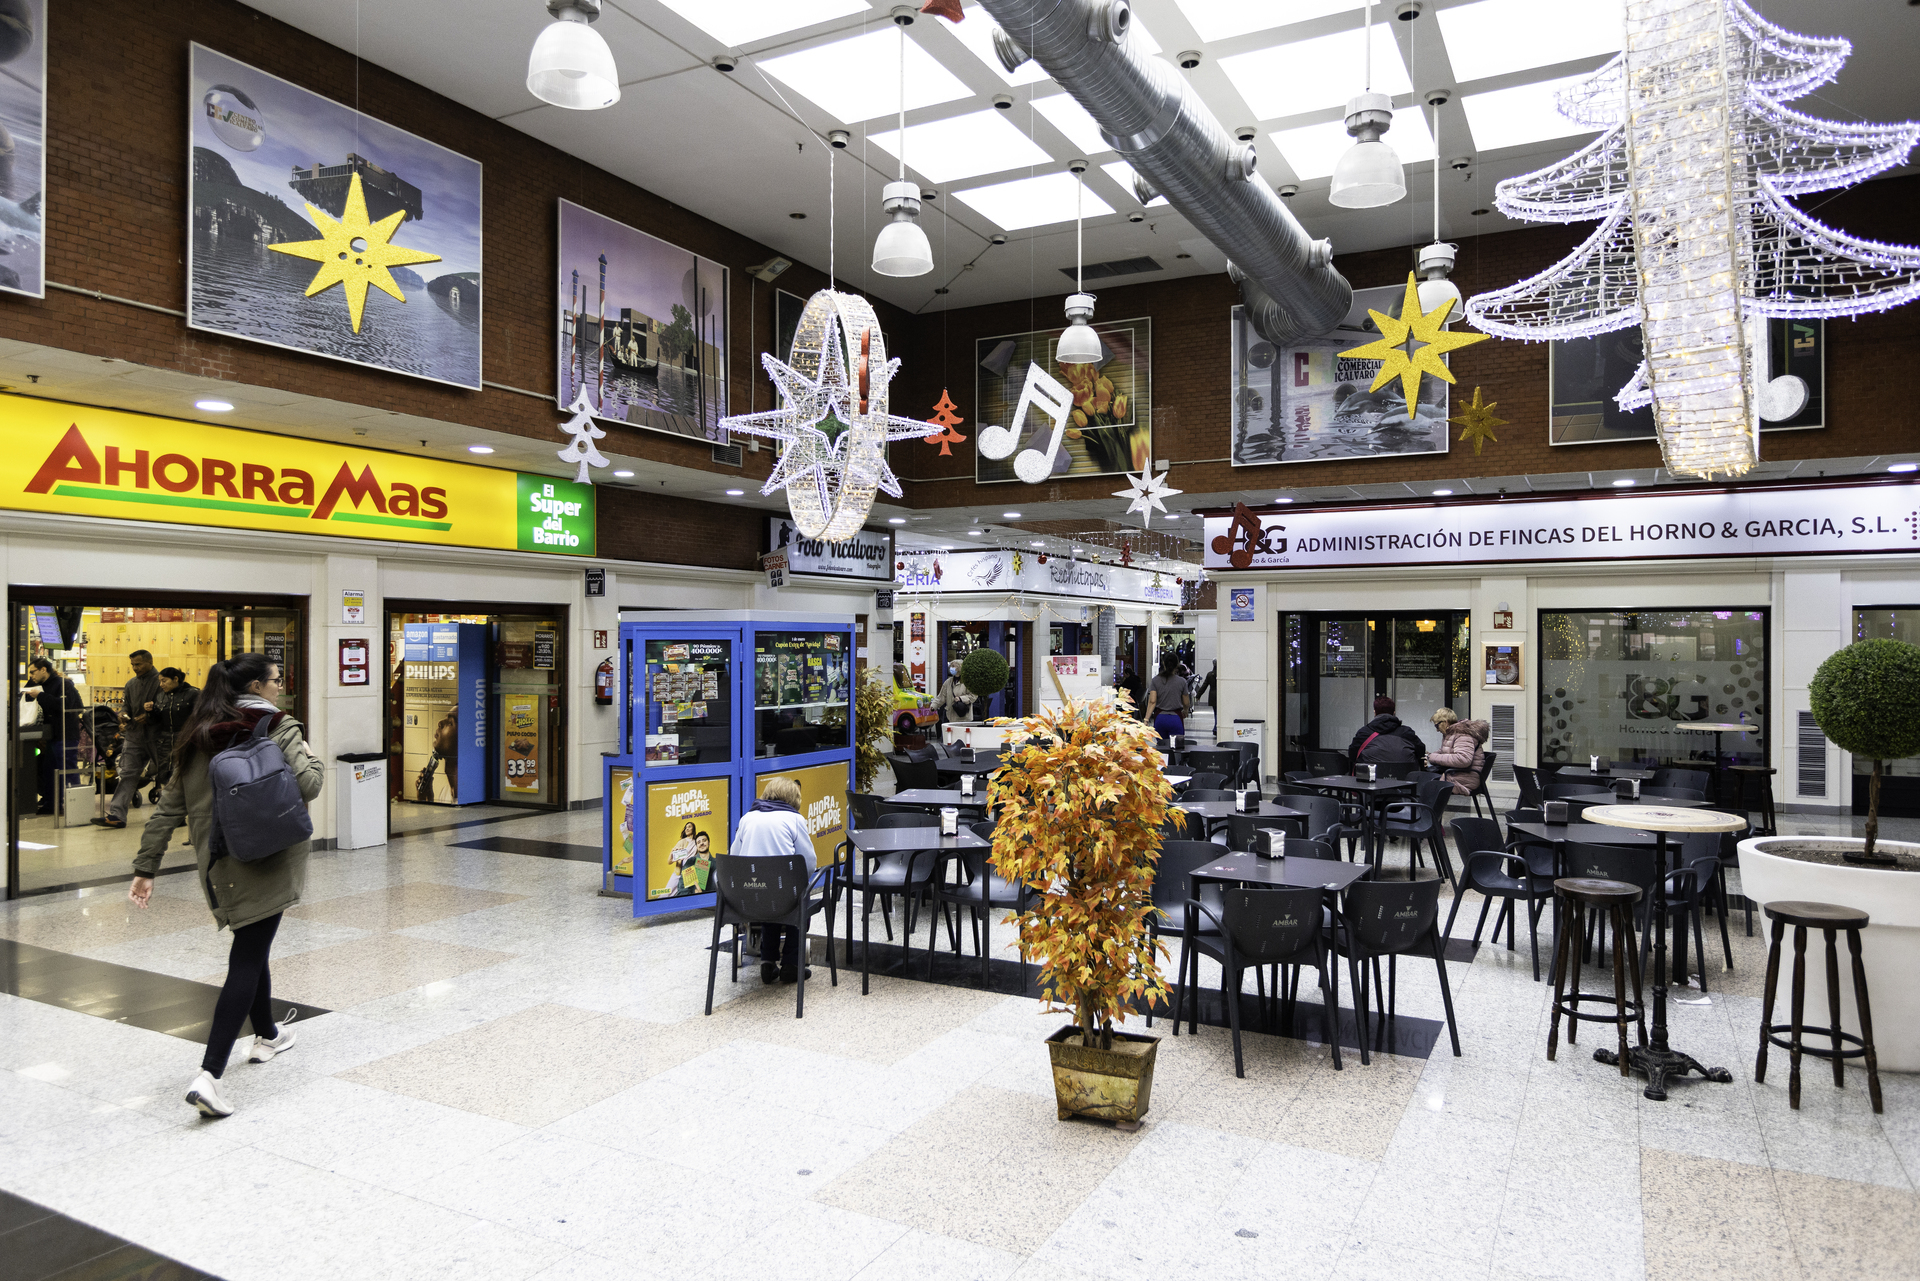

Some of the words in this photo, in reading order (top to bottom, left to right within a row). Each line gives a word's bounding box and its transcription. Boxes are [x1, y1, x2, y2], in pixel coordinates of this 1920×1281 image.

[1337, 360, 1383, 372] COMERCIAL
[543, 483, 555, 498] El
[530, 492, 582, 520] Super
[542, 516, 563, 531] del
[533, 526, 580, 547] Barrio
[1296, 529, 1462, 553] ADMINISTRACIÓN
[1468, 530, 1495, 547] DE
[1499, 526, 1575, 546] FINCAS
[1582, 525, 1623, 543] DEL
[1630, 521, 1716, 541] HORNO
[1721, 521, 1738, 539] &
[1745, 517, 1844, 539] GARCIA,
[1851, 515, 1898, 534] S.L.
[763, 555, 784, 564] FOTOS
[763, 561, 788, 571] CARNET
[1267, 556, 1290, 564] García
[406, 630, 428, 638] amazon
[405, 665, 456, 680] PHILIPS
[475, 678, 486, 748] amazon
[671, 789, 703, 805] AHORA
[665, 798, 710, 818] SIEMPRE
[693, 810, 713, 818] JUGADO
[808, 795, 835, 818] AHORA
[1586, 869, 1609, 877] AMBAR
[1394, 910, 1419, 918] AMBAR
[1272, 919, 1299, 927] AMBAR
